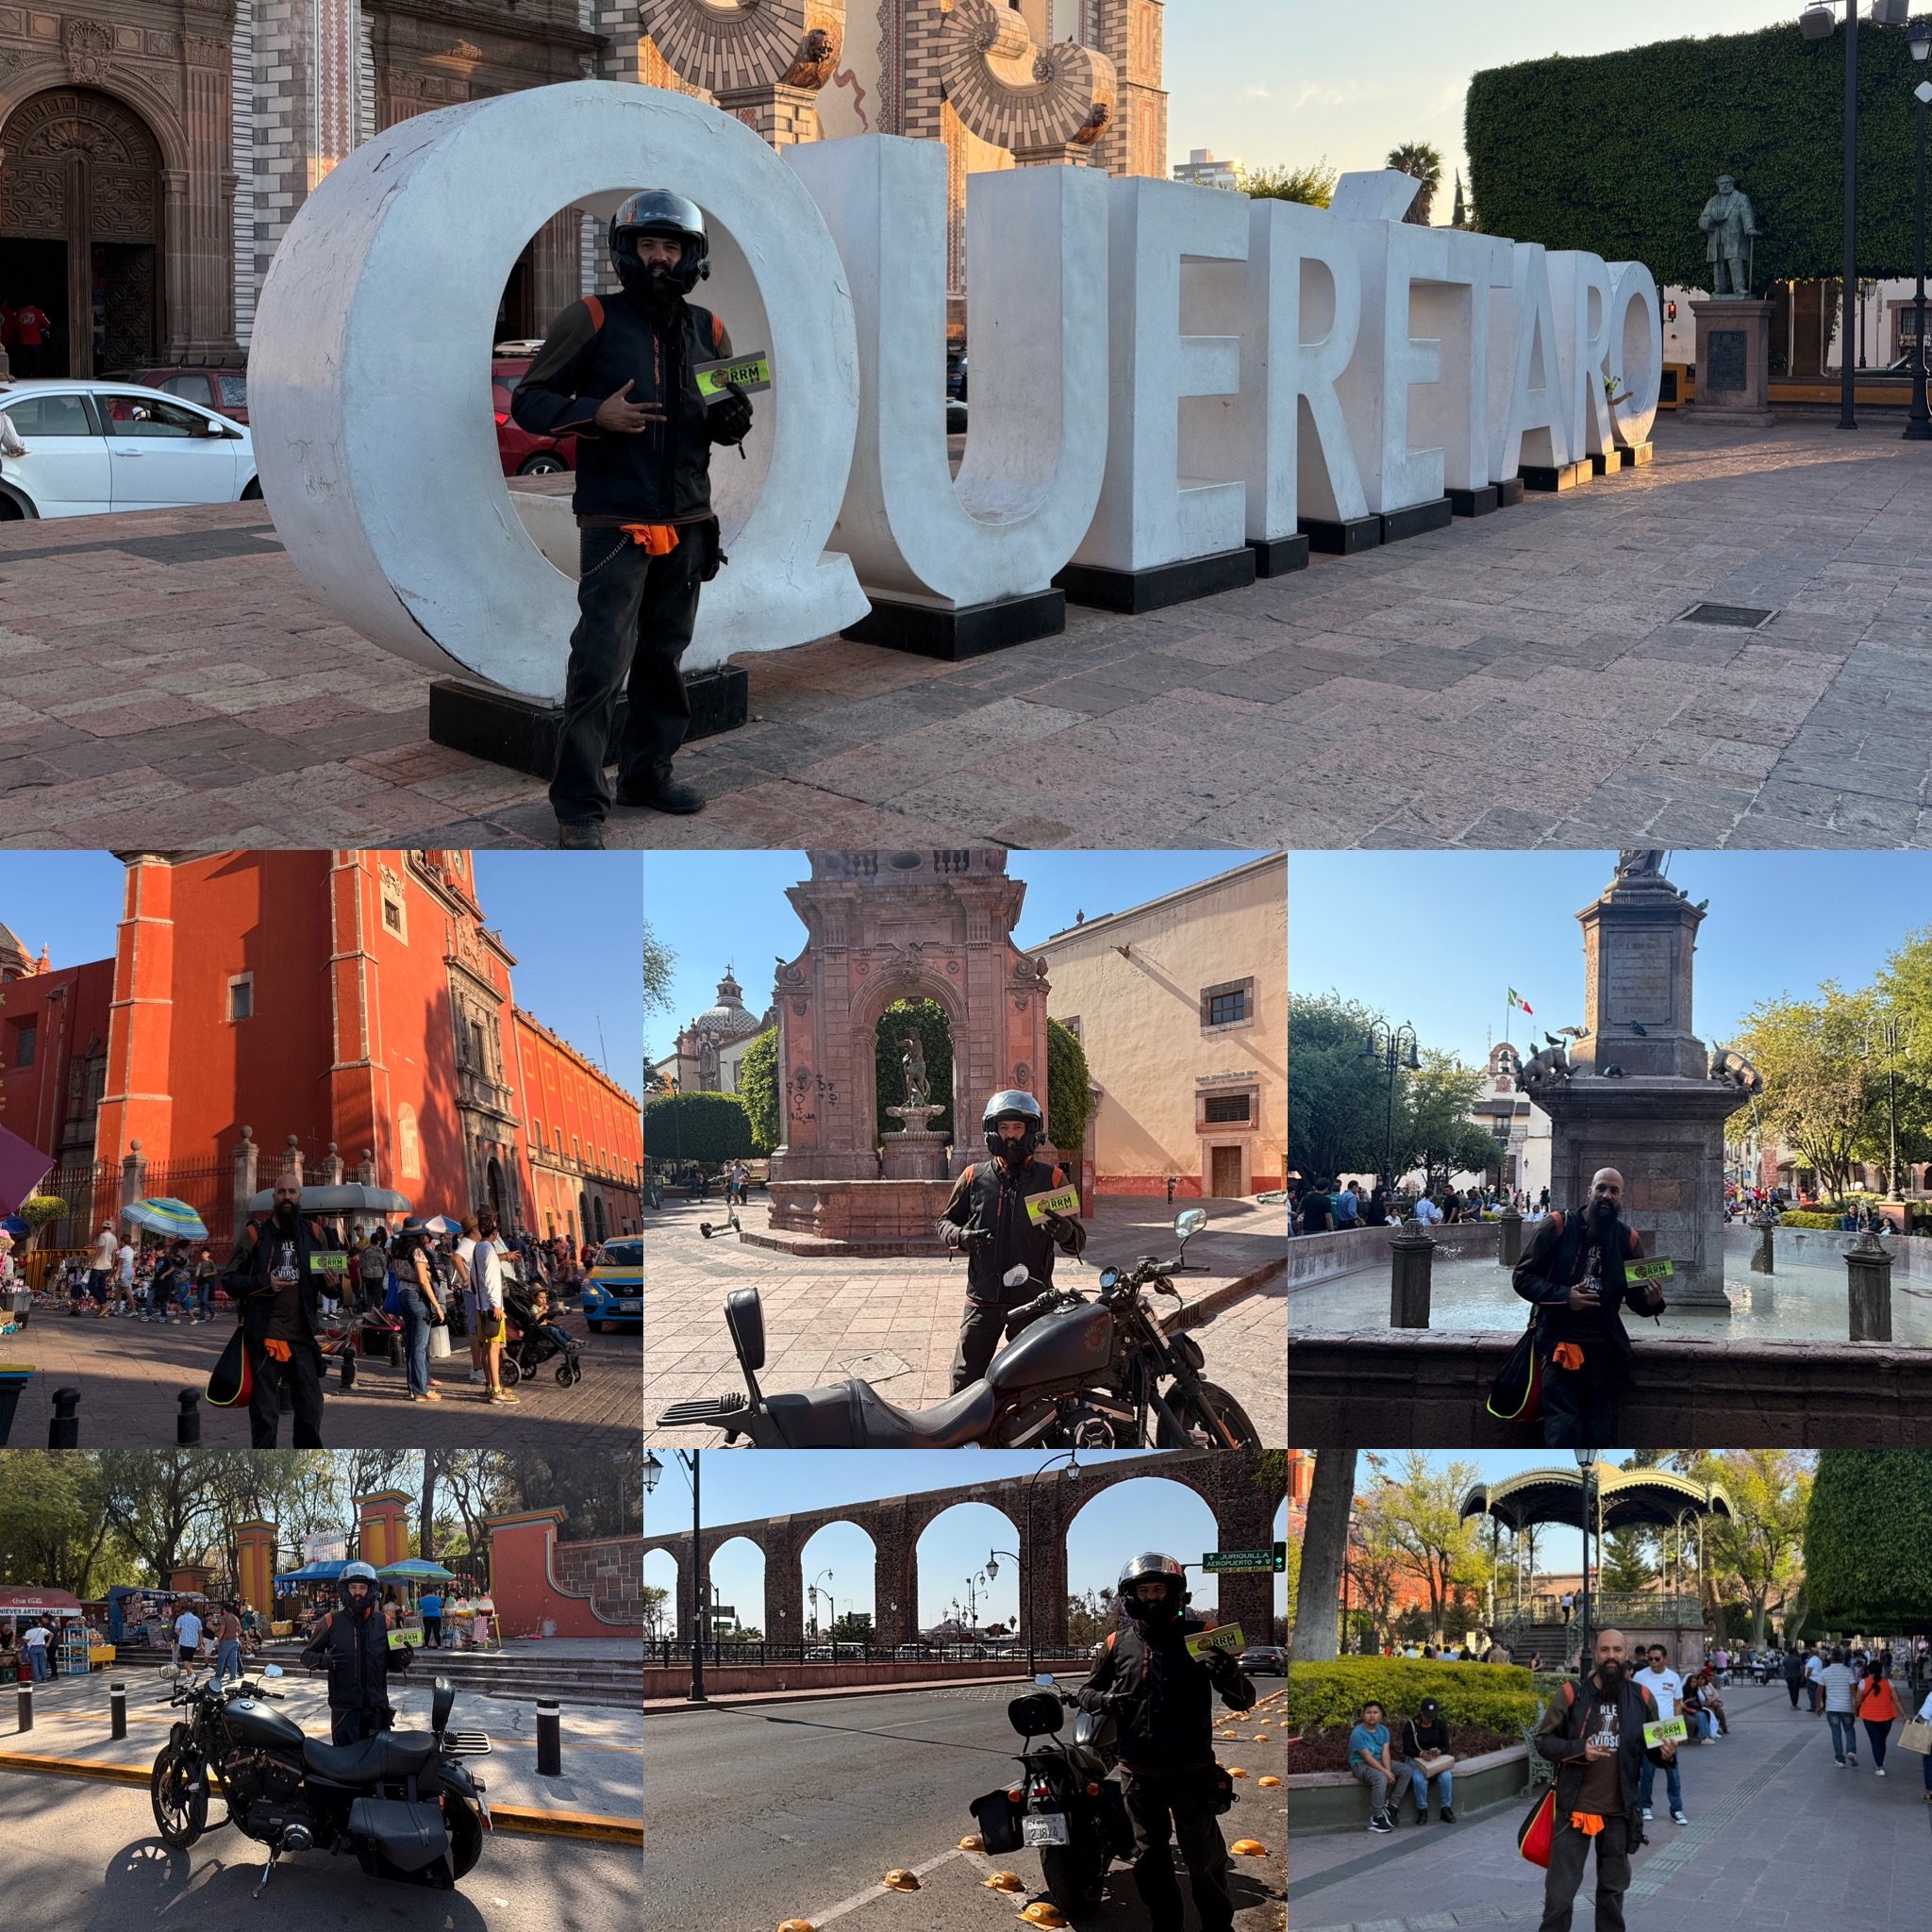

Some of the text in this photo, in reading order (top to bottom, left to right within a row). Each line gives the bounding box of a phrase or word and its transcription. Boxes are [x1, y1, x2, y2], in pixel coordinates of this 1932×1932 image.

[730, 366, 759, 382] RRM
[247, 80, 1662, 706] QUERÉTARO
[1051, 1197, 1072, 1208] RRM
[281, 1239, 295, 1252] RLE
[277, 1268, 300, 1280] VIDSO
[1647, 1265, 1666, 1275] RRM
[1220, 1552, 1269, 1560] JURIQUILLA
[404, 1634, 418, 1642] RRM
[1212, 1634, 1236, 1647] RRM
[1600, 1705, 1618, 1716] RLE
[1663, 1724, 1681, 1735] RRM
[1591, 1735, 1620, 1747] VIDSO
